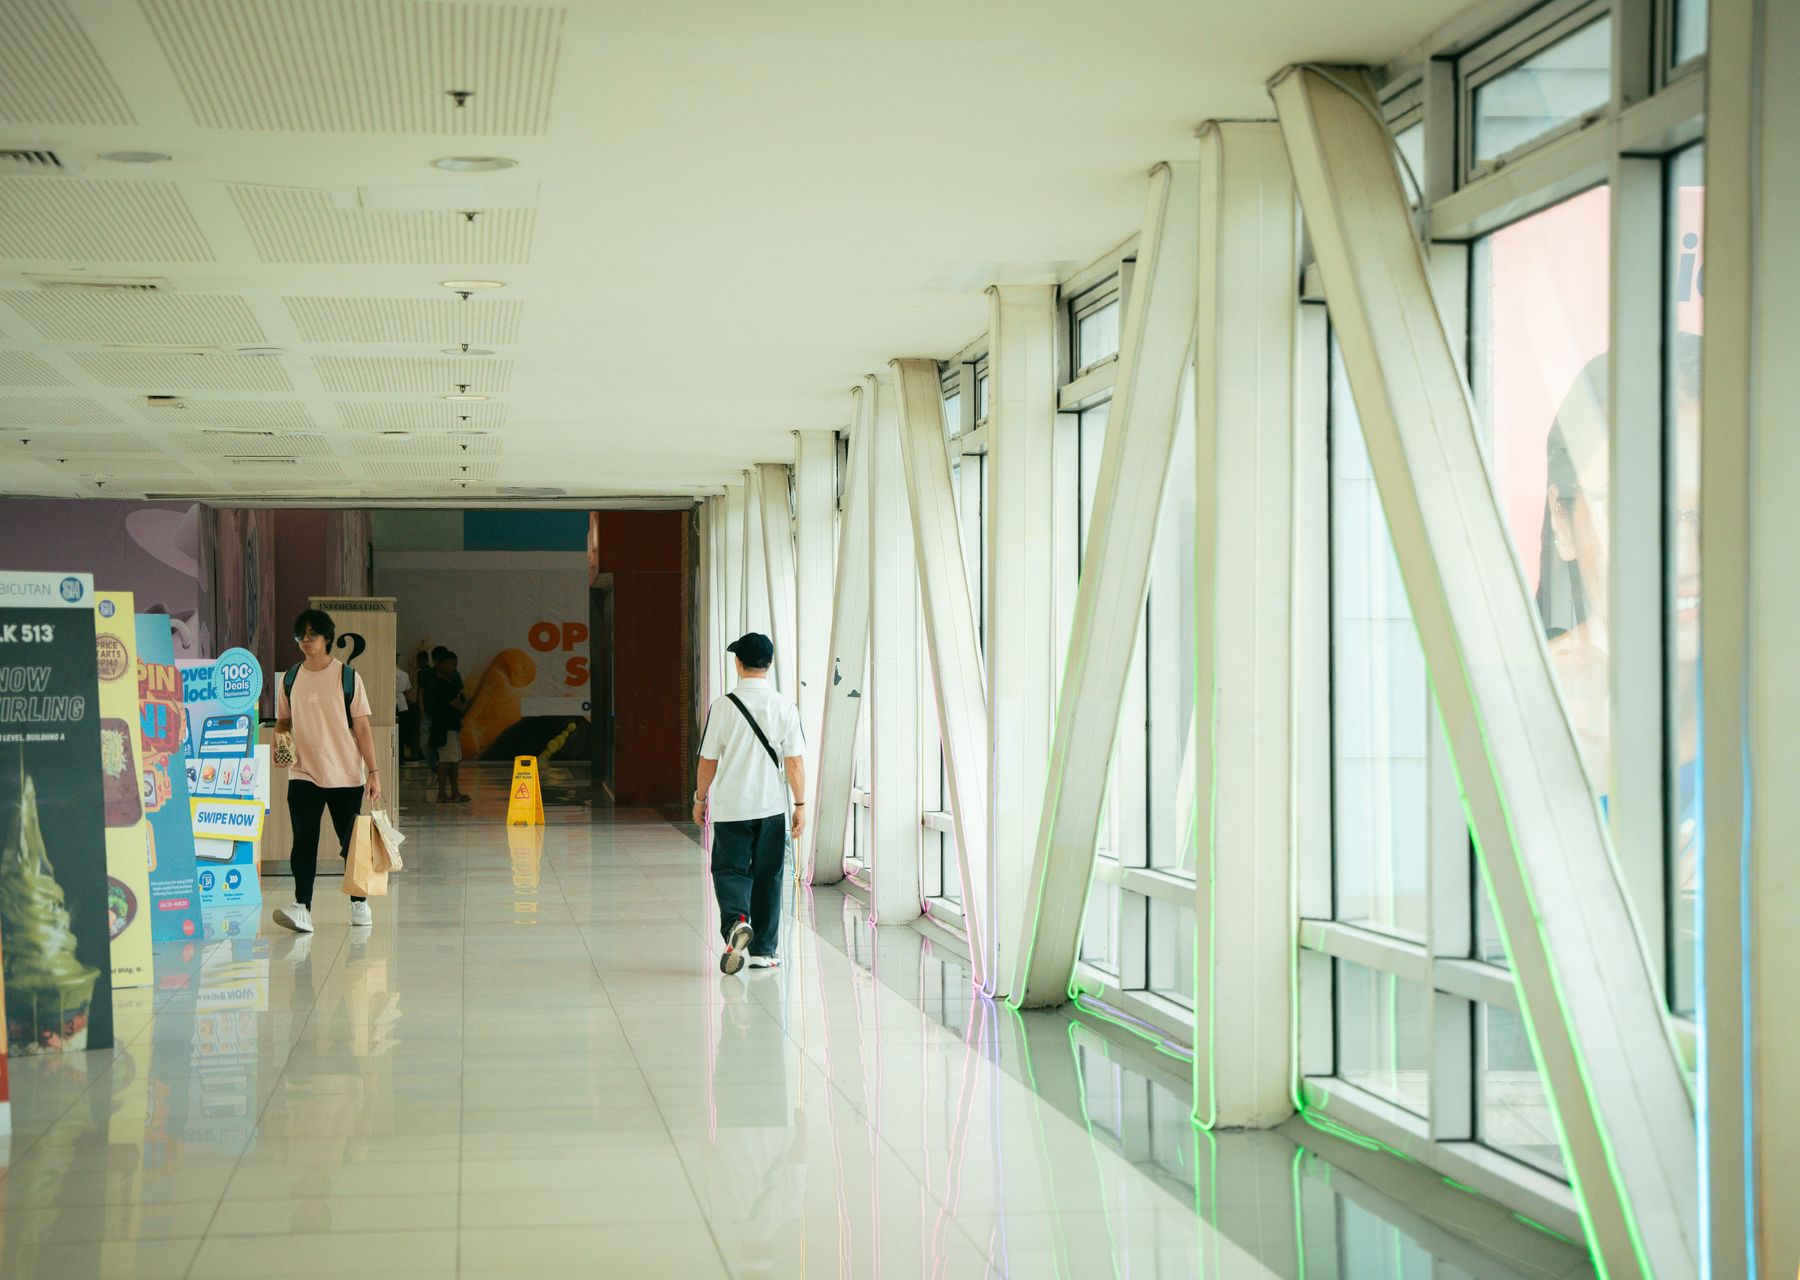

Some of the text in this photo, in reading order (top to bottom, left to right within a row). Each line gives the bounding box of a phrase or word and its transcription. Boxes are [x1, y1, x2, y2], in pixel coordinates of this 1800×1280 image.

[0, 583, 52, 596] BICUTAN
[319, 602, 387, 611] INFORMATION
[21, 624, 54, 643] 513
[528, 621, 589, 652] OP
[0, 666, 52, 692] NOW
[225, 680, 250, 691] Deals
[0, 696, 86, 722] IRLING
[197, 811, 254, 826] SWIPE NOW
